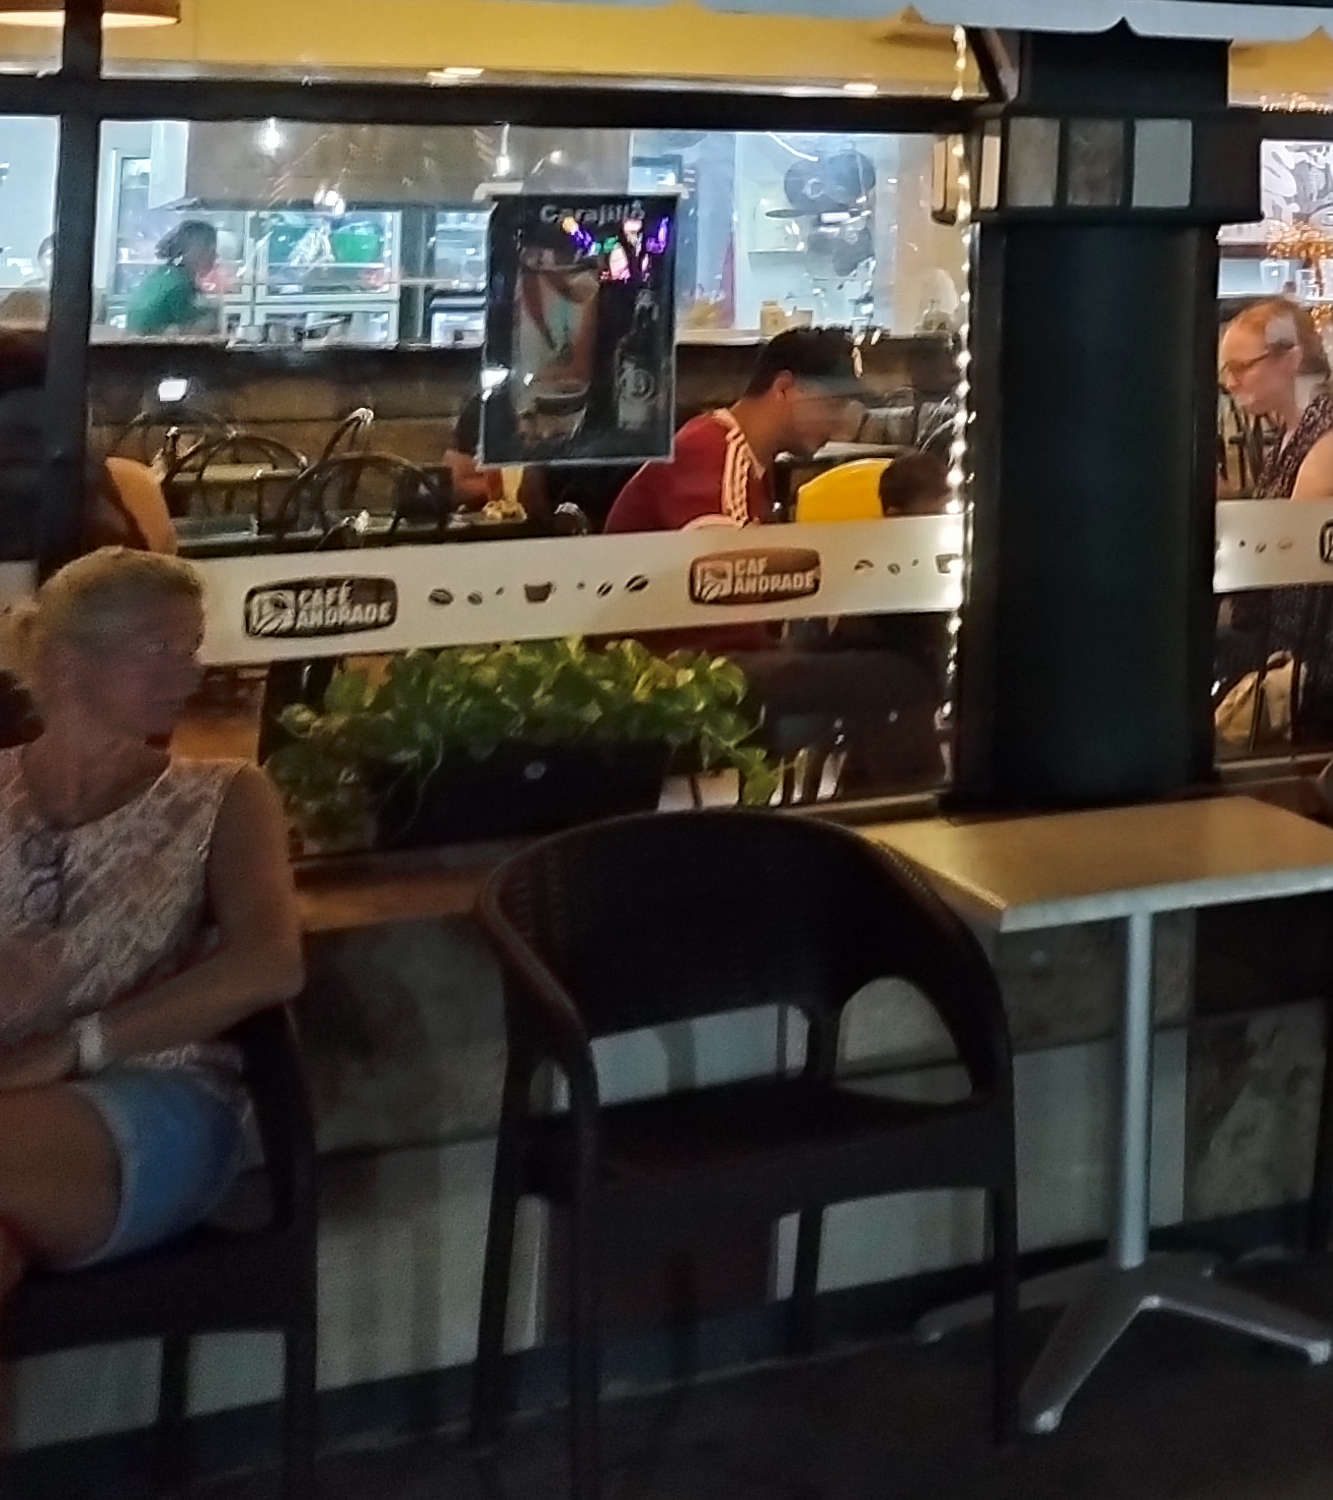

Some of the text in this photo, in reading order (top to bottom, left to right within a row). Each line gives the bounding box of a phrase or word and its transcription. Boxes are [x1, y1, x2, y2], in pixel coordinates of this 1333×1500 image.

[298, 579, 353, 609] CAFÉ
[733, 569, 816, 595] ANDRADE
[296, 601, 393, 630] ANDRADE
